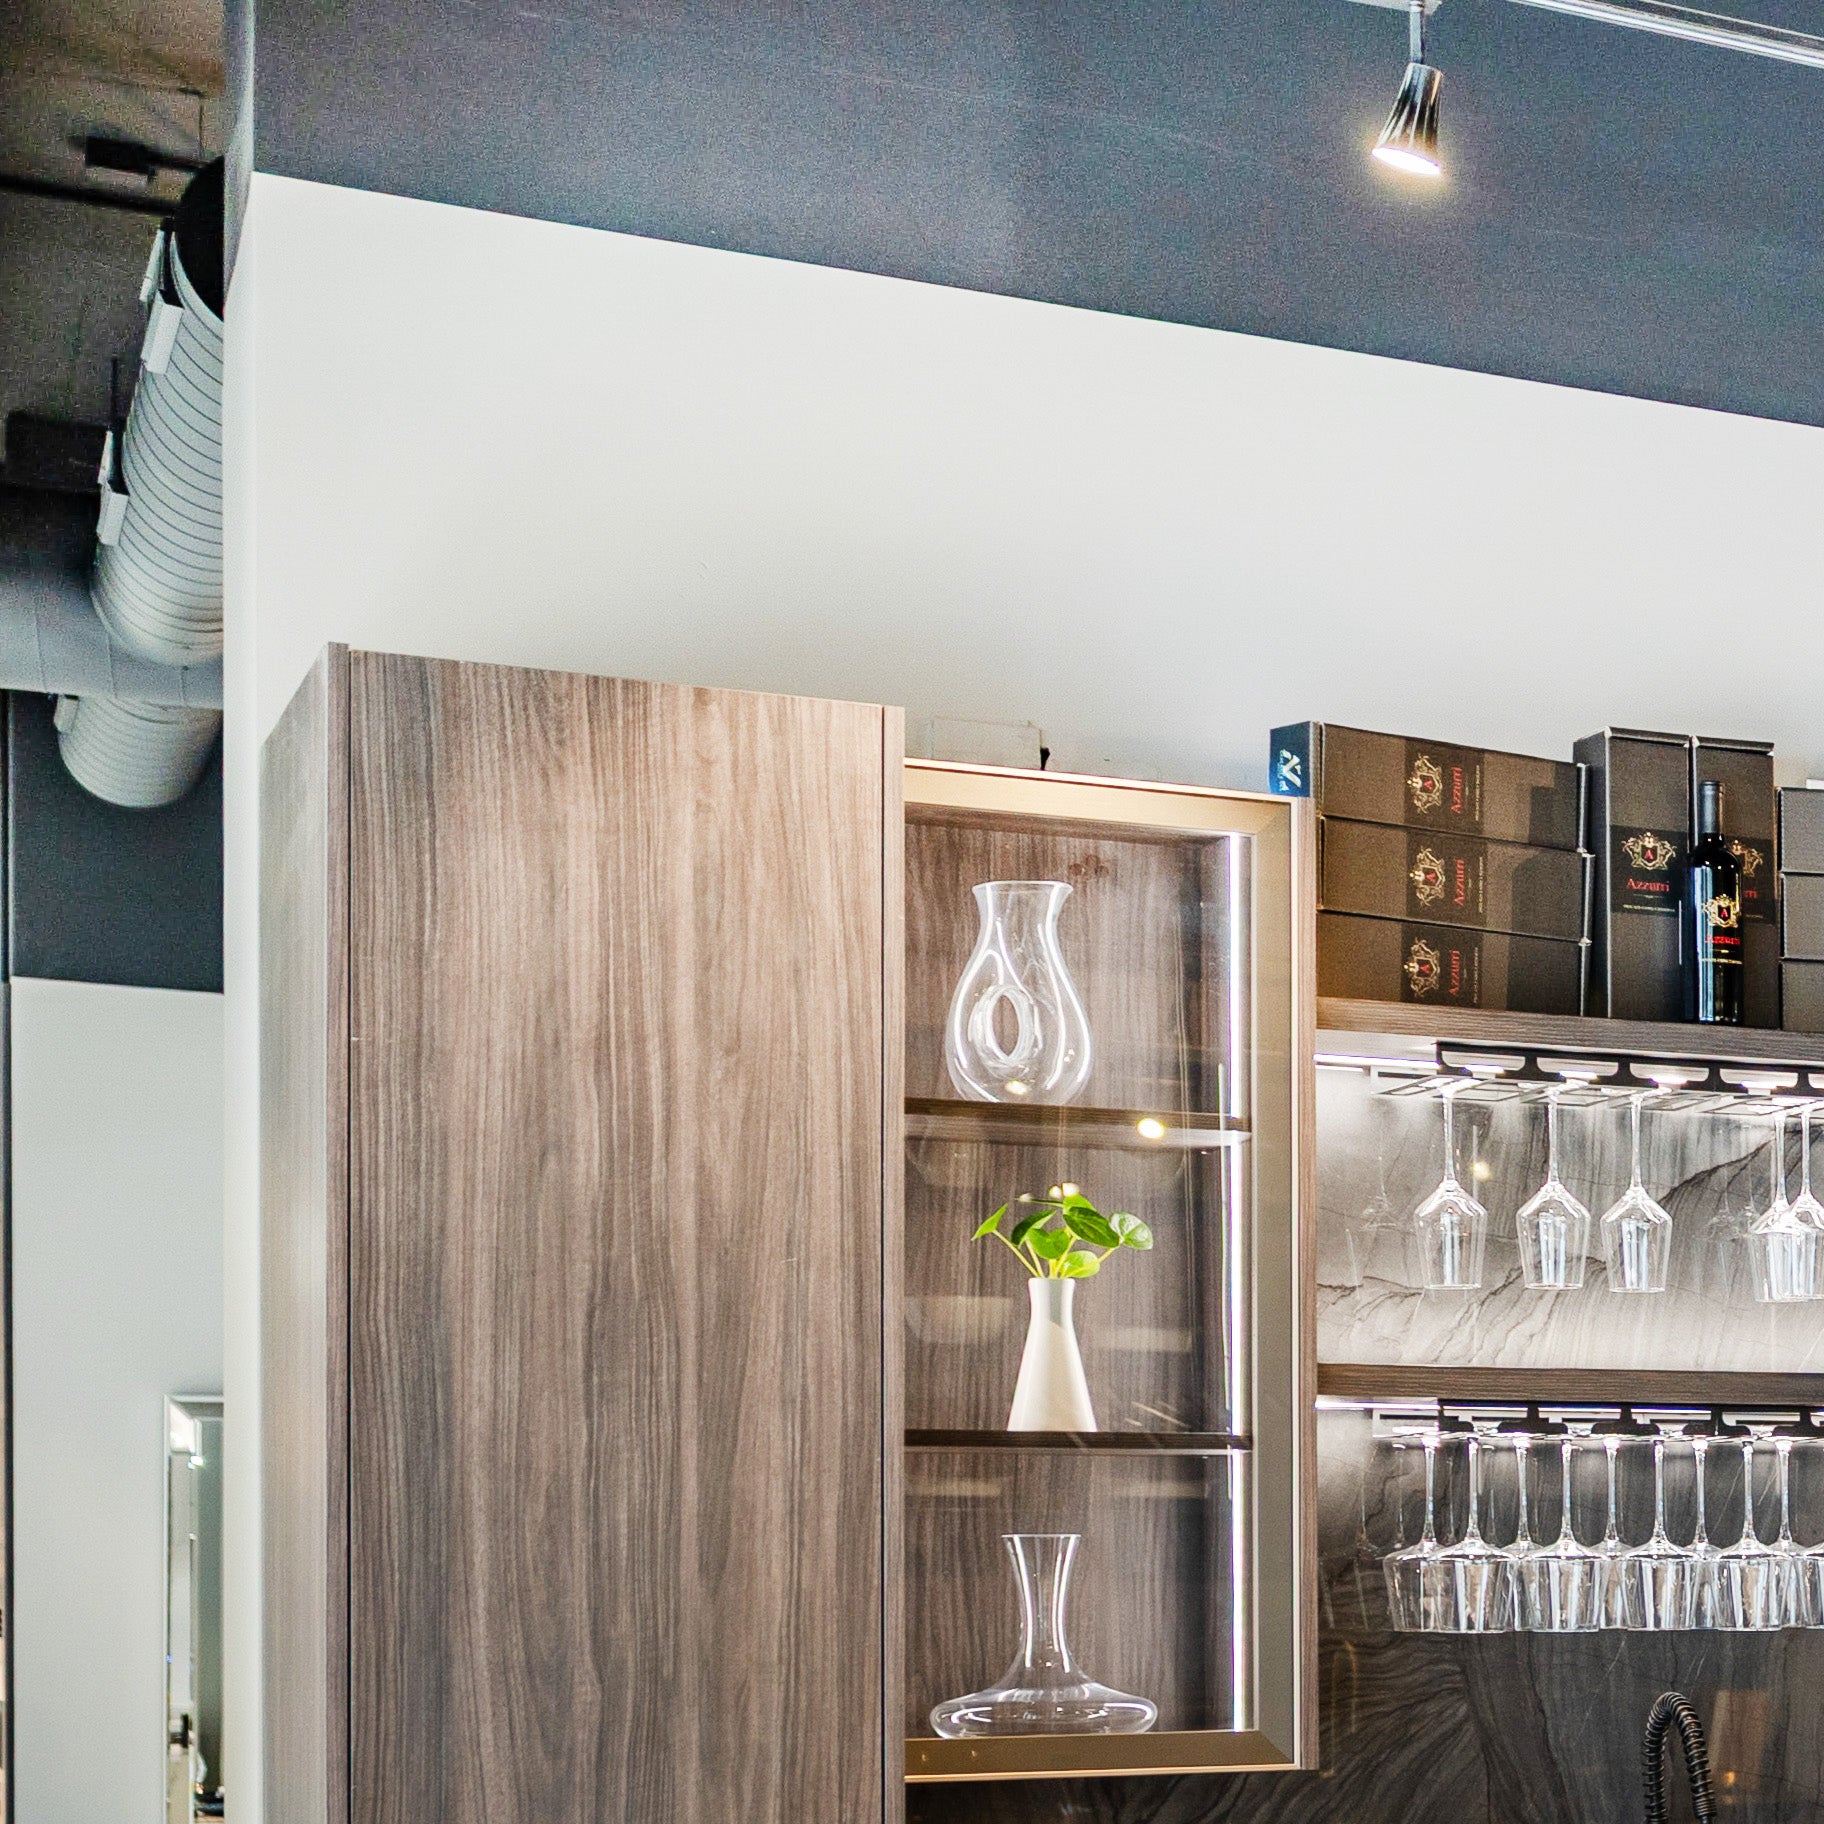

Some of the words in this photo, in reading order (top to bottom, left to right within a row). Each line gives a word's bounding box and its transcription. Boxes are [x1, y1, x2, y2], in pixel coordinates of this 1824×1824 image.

[1450, 765, 1464, 815] Azzurri
[1453, 858, 1467, 908] Azzurri
[1626, 878, 1671, 893] Azzurri
[1448, 948, 1461, 996] Azzurri
